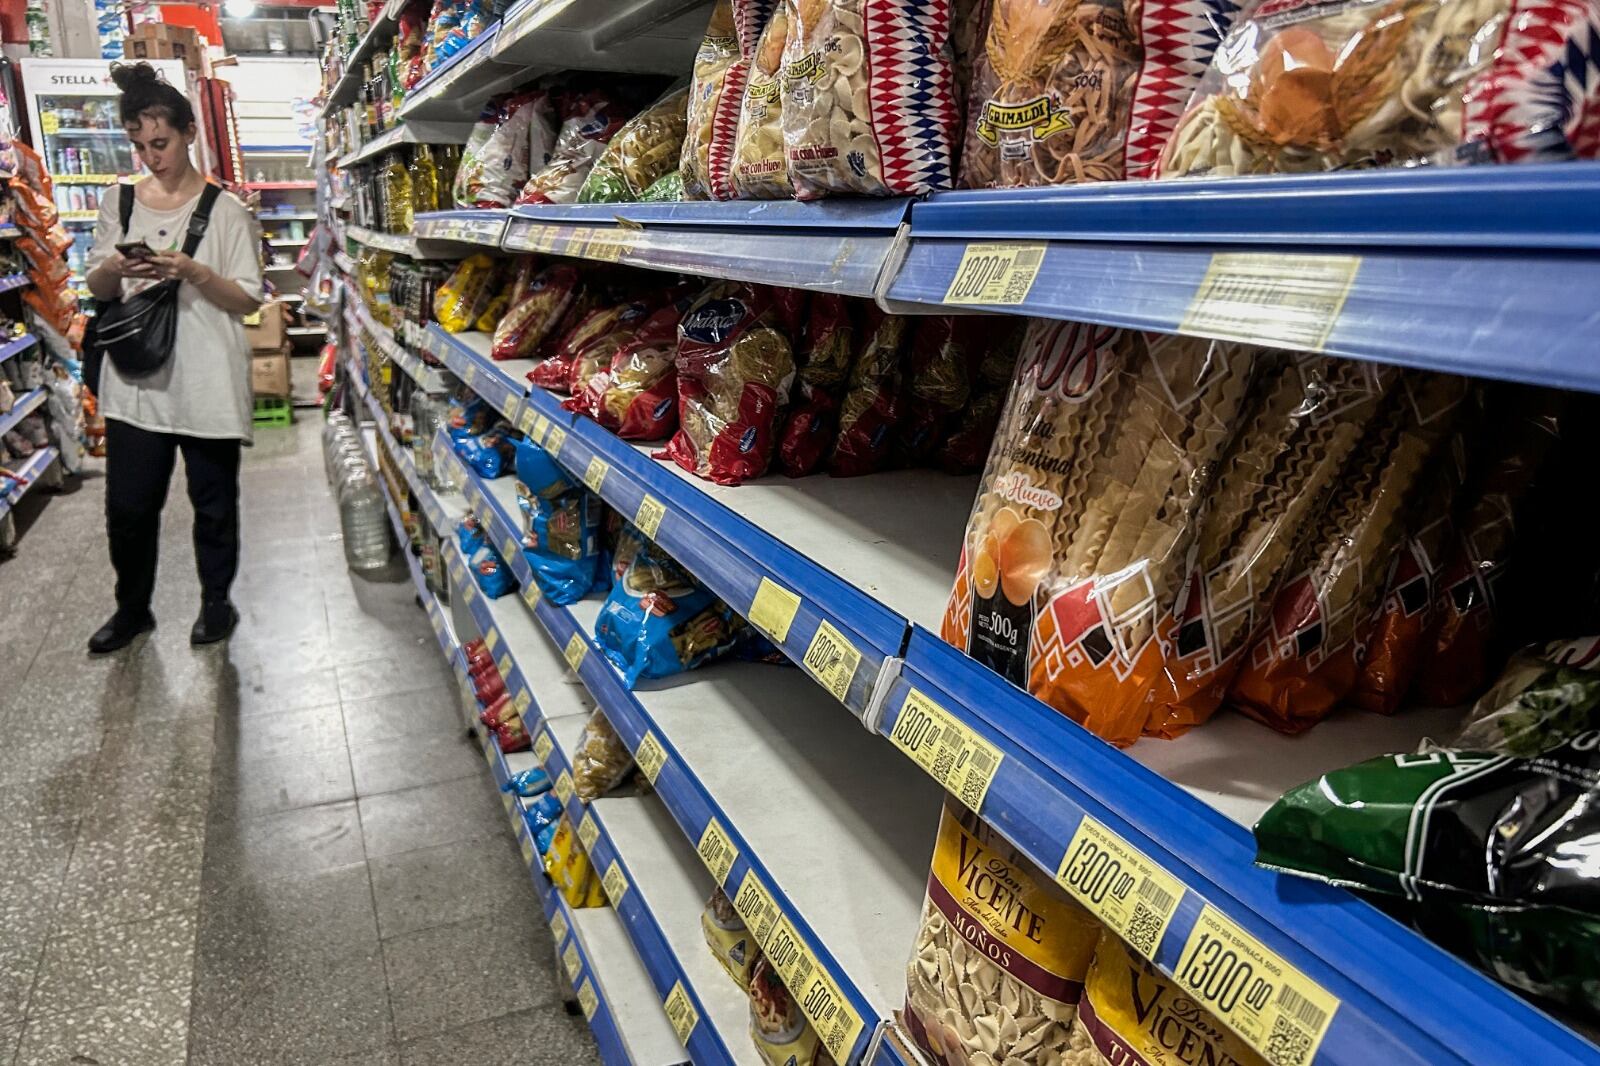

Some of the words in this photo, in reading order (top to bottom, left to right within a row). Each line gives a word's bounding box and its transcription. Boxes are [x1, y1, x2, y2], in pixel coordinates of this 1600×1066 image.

[51, 76, 97, 84] STELLA
[988, 104, 1046, 125] GRIMALDI
[949, 255, 999, 297] 1300
[1008, 475, 1058, 507] Huevo
[989, 611, 1018, 645] 500g
[807, 632, 836, 673] 1300
[893, 703, 932, 752] 1300
[925, 725, 941, 747] 00
[702, 831, 719, 862] 500
[1082, 822, 1101, 838] FIDEOS
[1099, 833, 1108, 844] DE
[1106, 839, 1128, 859] SEMOLA
[957, 832, 1046, 944] VICENTE
[985, 858, 1022, 892] Don
[1062, 838, 1121, 904] 1300
[1112, 872, 1136, 900] 00
[738, 883, 757, 918] 500
[769, 929, 794, 967] 500
[952, 912, 1011, 967] MOÑOS
[1200, 913, 1221, 932] FIDEO
[1231, 936, 1264, 964] ESPINACA
[1181, 932, 1254, 1013] 1300
[1245, 977, 1274, 1011] 00
[804, 979, 831, 1020] 500
[824, 1002, 837, 1020] 00
[1169, 997, 1225, 1043] Don
